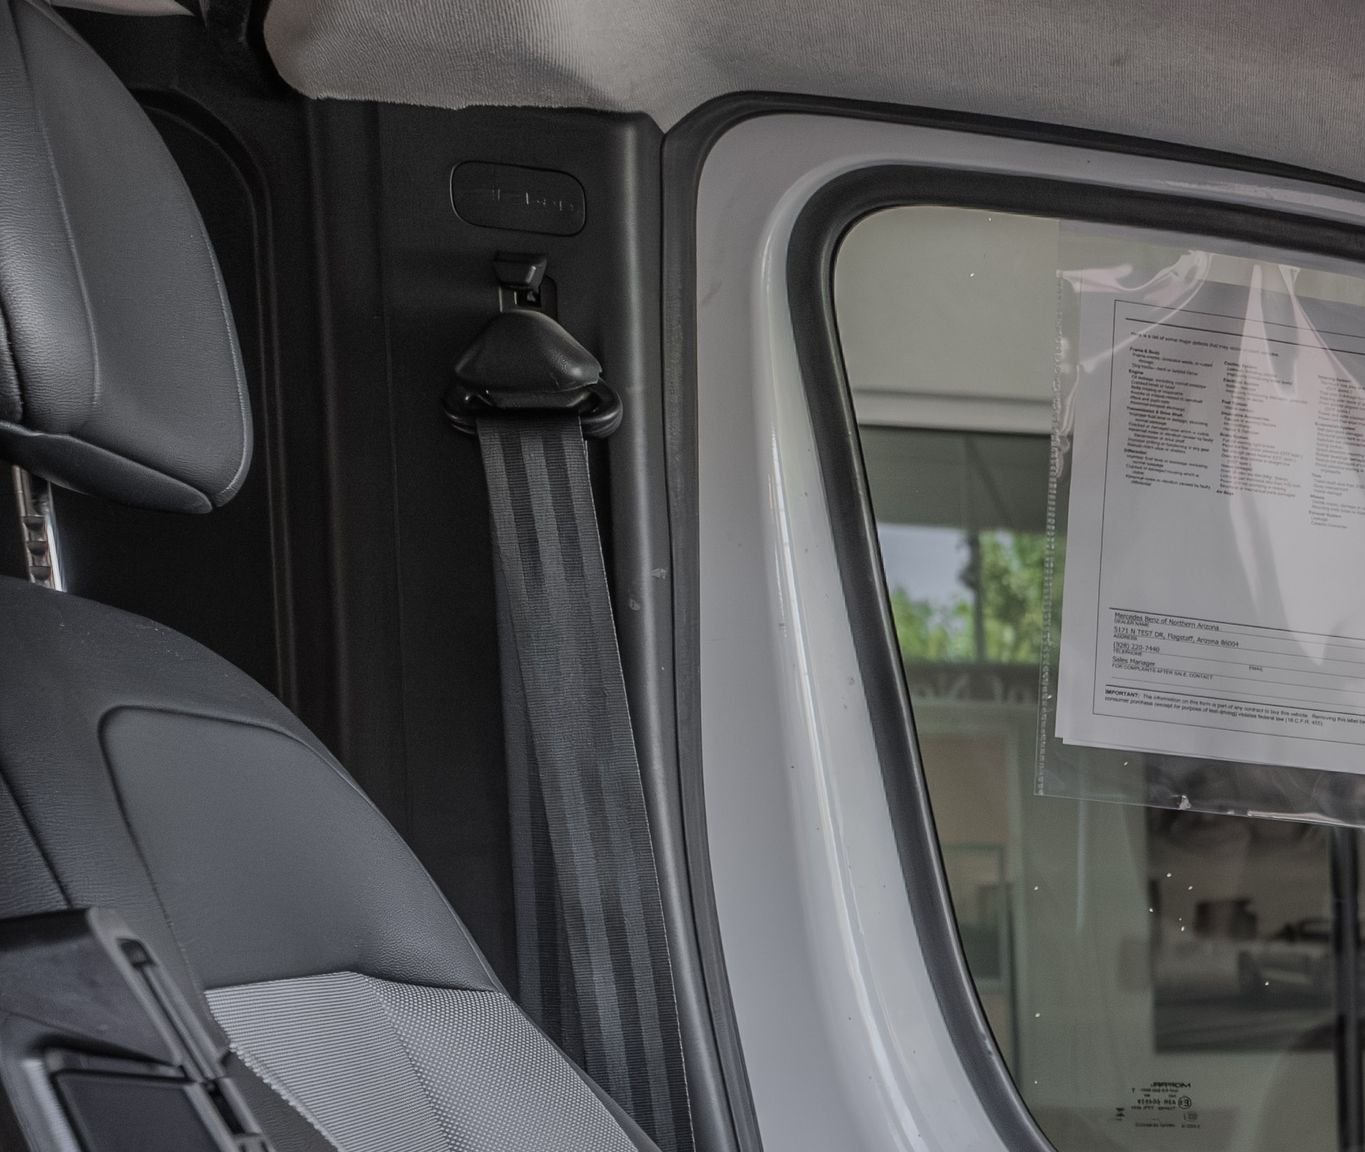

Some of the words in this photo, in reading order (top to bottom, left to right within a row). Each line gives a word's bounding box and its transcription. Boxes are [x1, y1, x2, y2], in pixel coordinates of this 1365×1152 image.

[1114, 612, 1143, 622] Mercedes
[1144, 616, 1159, 624] Benz
[1168, 619, 1196, 628] Northern
[1198, 622, 1219, 632] Arizona
[1197, 637, 1219, 645] Arizona
[1112, 656, 1128, 664] Sales
[1130, 658, 1155, 667] Manager
